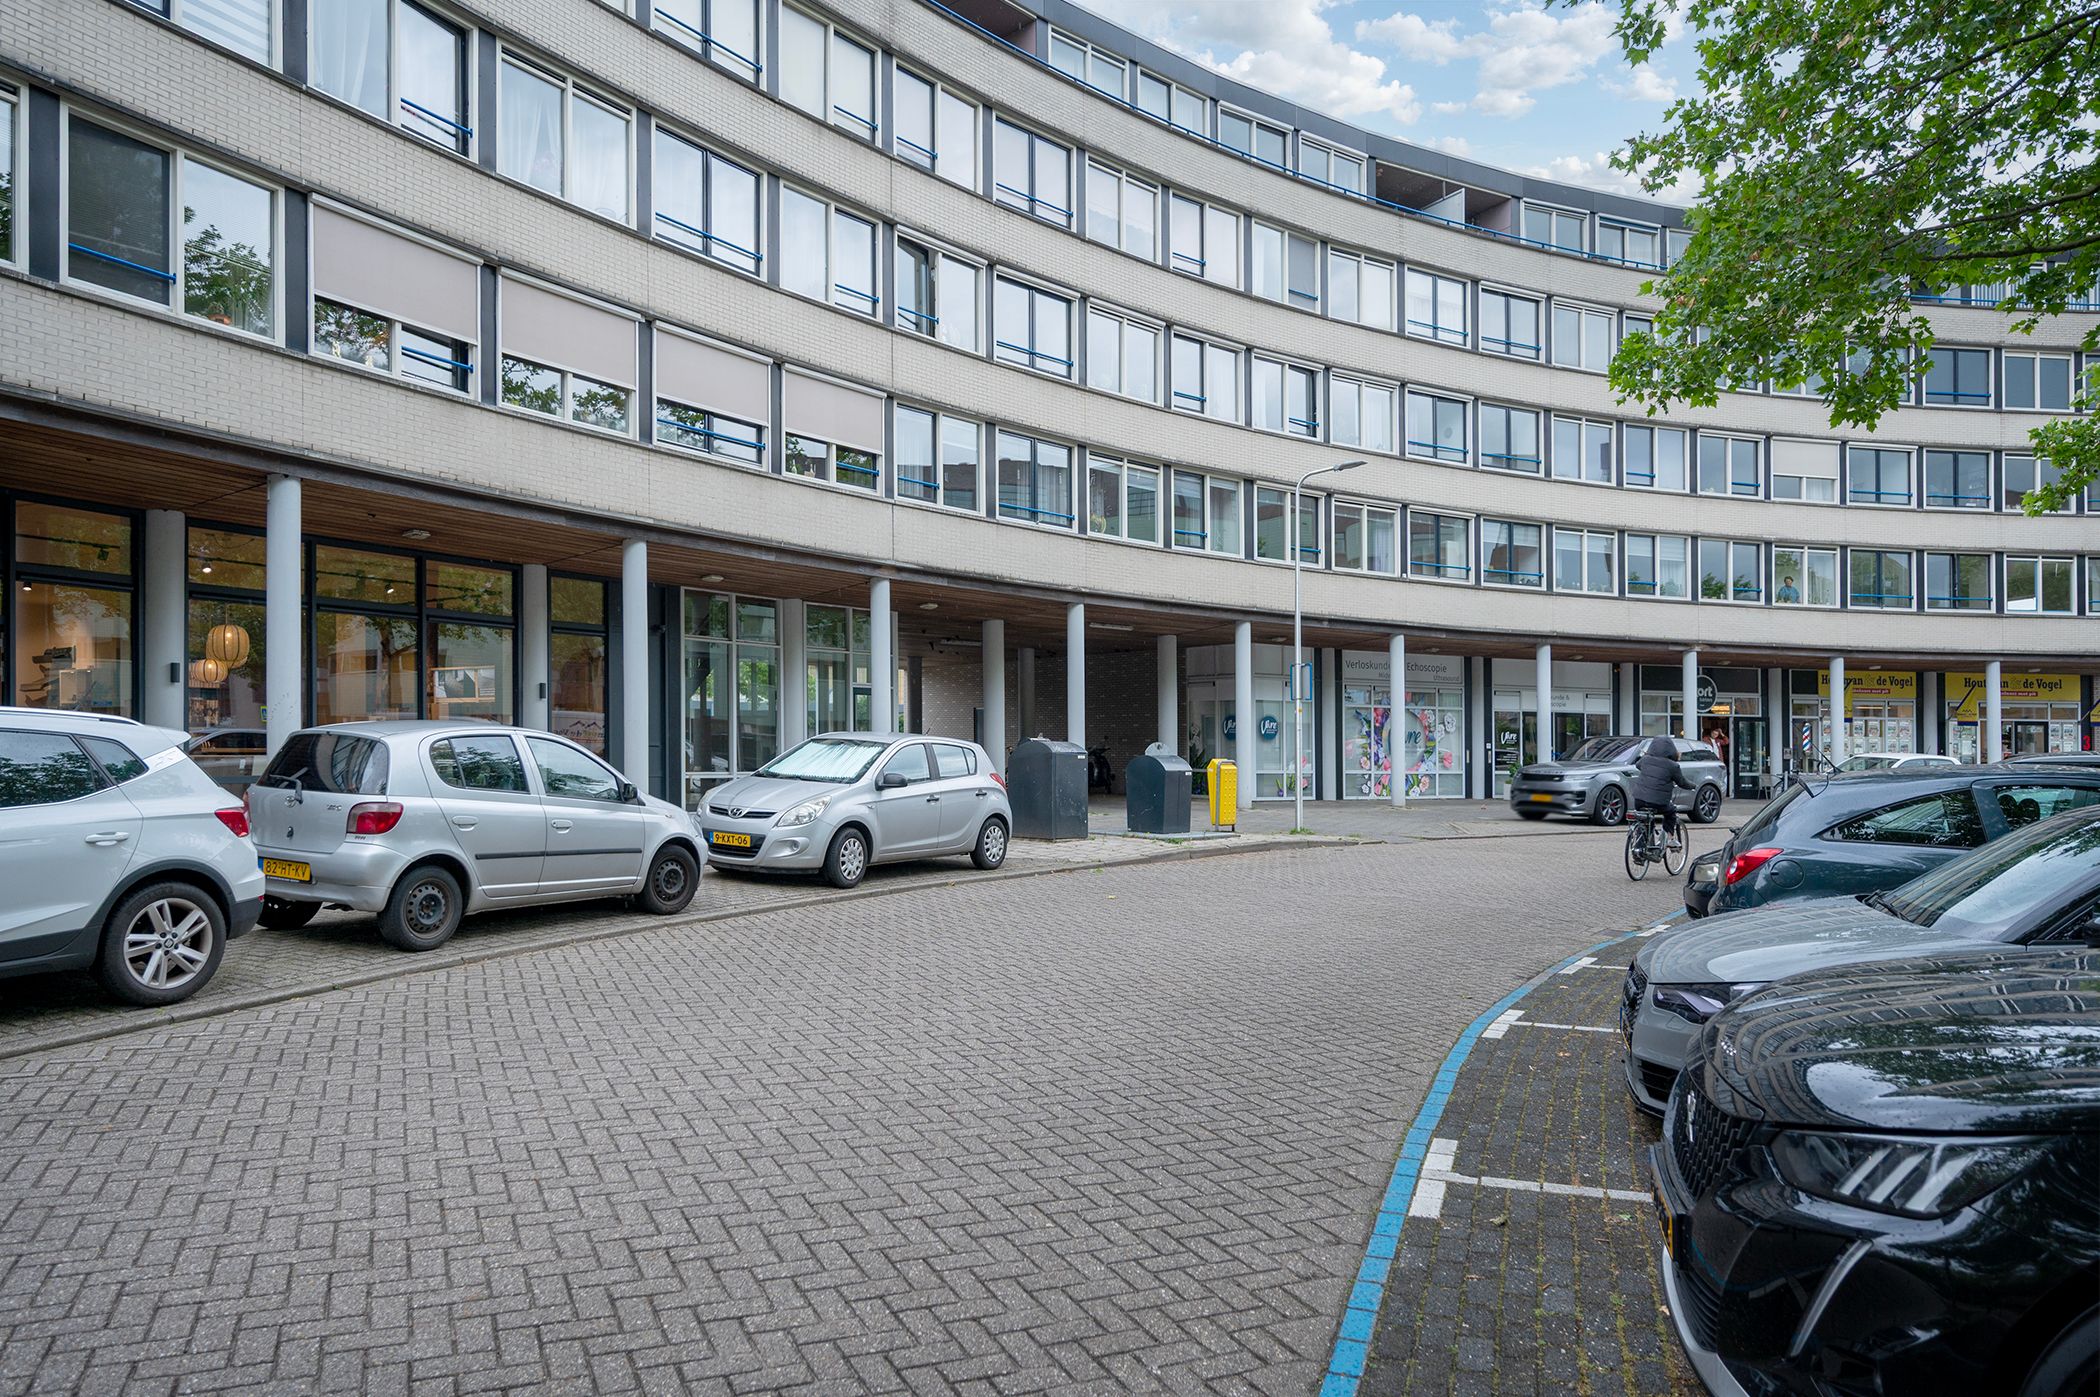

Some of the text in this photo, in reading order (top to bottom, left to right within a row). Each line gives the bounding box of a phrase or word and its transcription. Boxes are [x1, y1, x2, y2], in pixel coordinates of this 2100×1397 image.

[1406, 662, 1447, 674] Echoscopie
[1876, 676, 1887, 686] de
[1888, 676, 1913, 689] Vogel
[2022, 679, 2034, 689] de
[2035, 679, 2062, 691] Vogel
[1697, 687, 1712, 697] ort
[2083, 735, 2091, 751] 3
[715, 834, 748, 845] 9-KXT-06
[265, 861, 307, 878] 82-HT-KV
